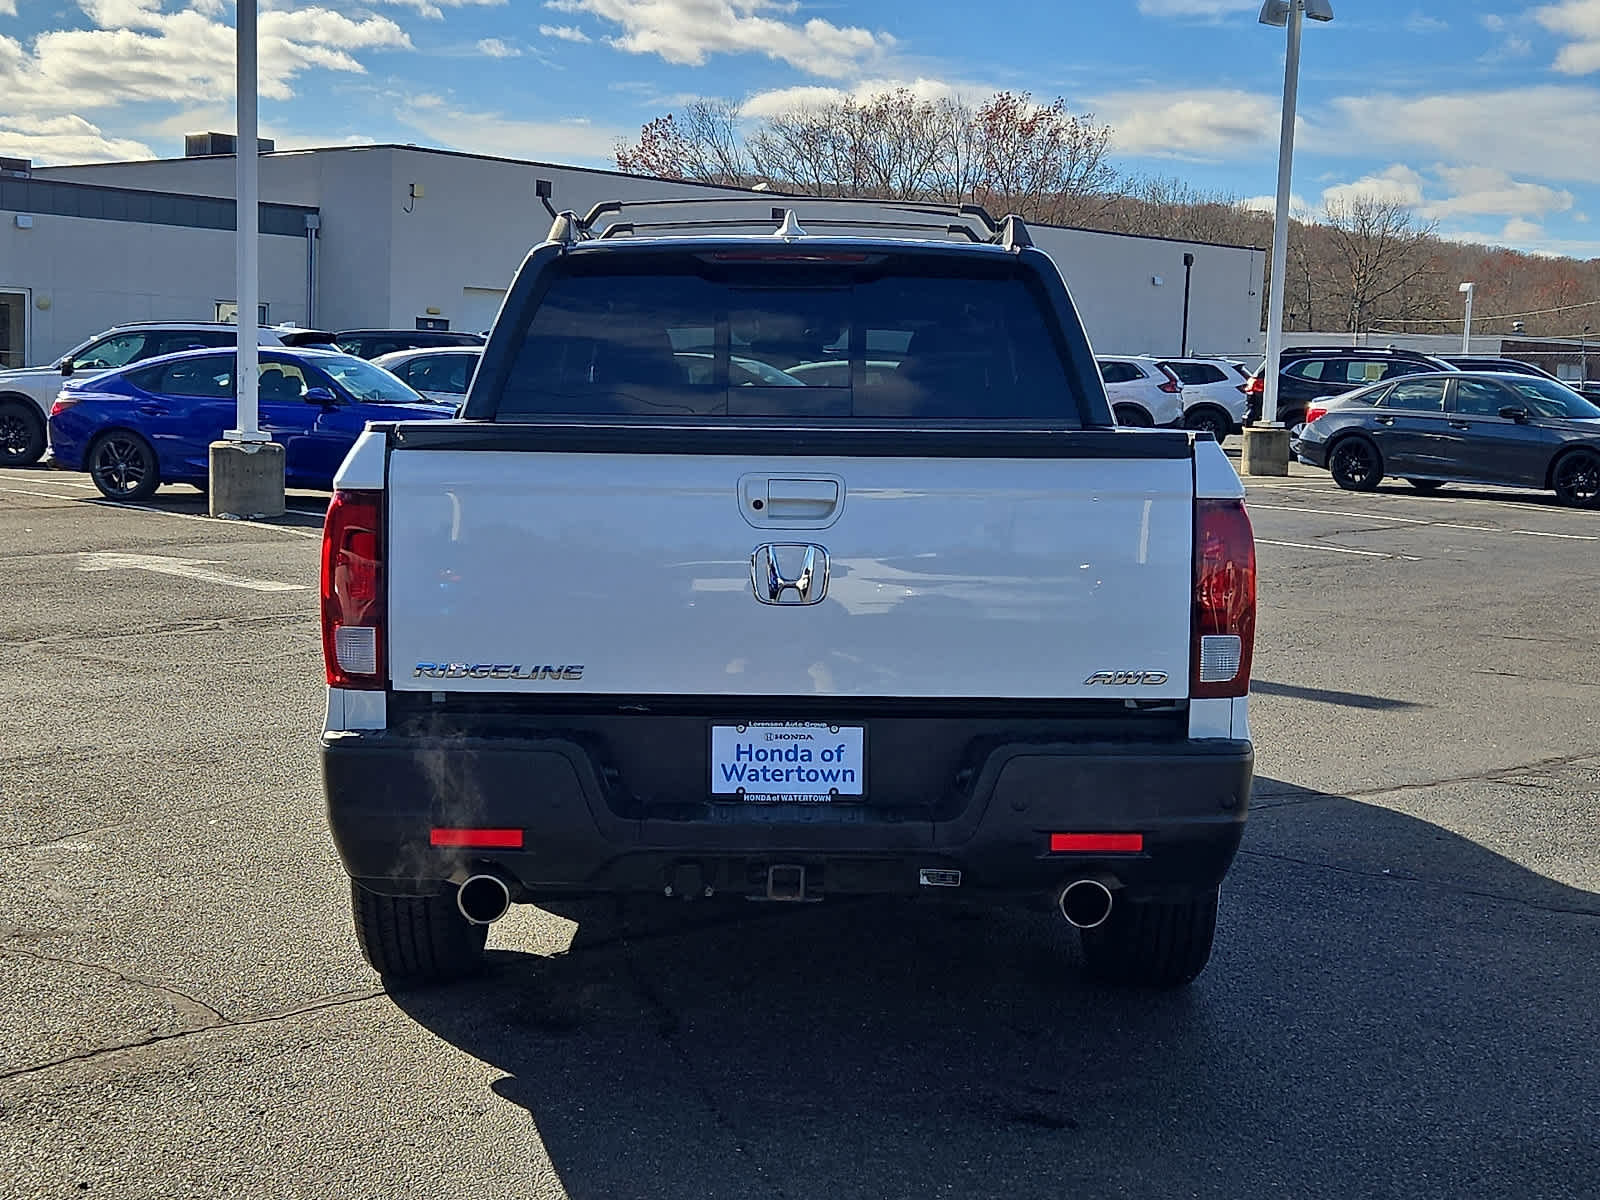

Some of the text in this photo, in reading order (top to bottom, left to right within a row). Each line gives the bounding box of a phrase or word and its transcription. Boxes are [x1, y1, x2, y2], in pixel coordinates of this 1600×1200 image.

[413, 662, 585, 680] RIDGELINE
[1083, 671, 1169, 685] AWD
[804, 721, 828, 729] Group
[775, 733, 815, 741] HONDA
[735, 743, 846, 763] Honda of
[720, 763, 856, 783] Watertown
[743, 794, 772, 802] HONDA
[781, 794, 832, 802] WATERTOWN
